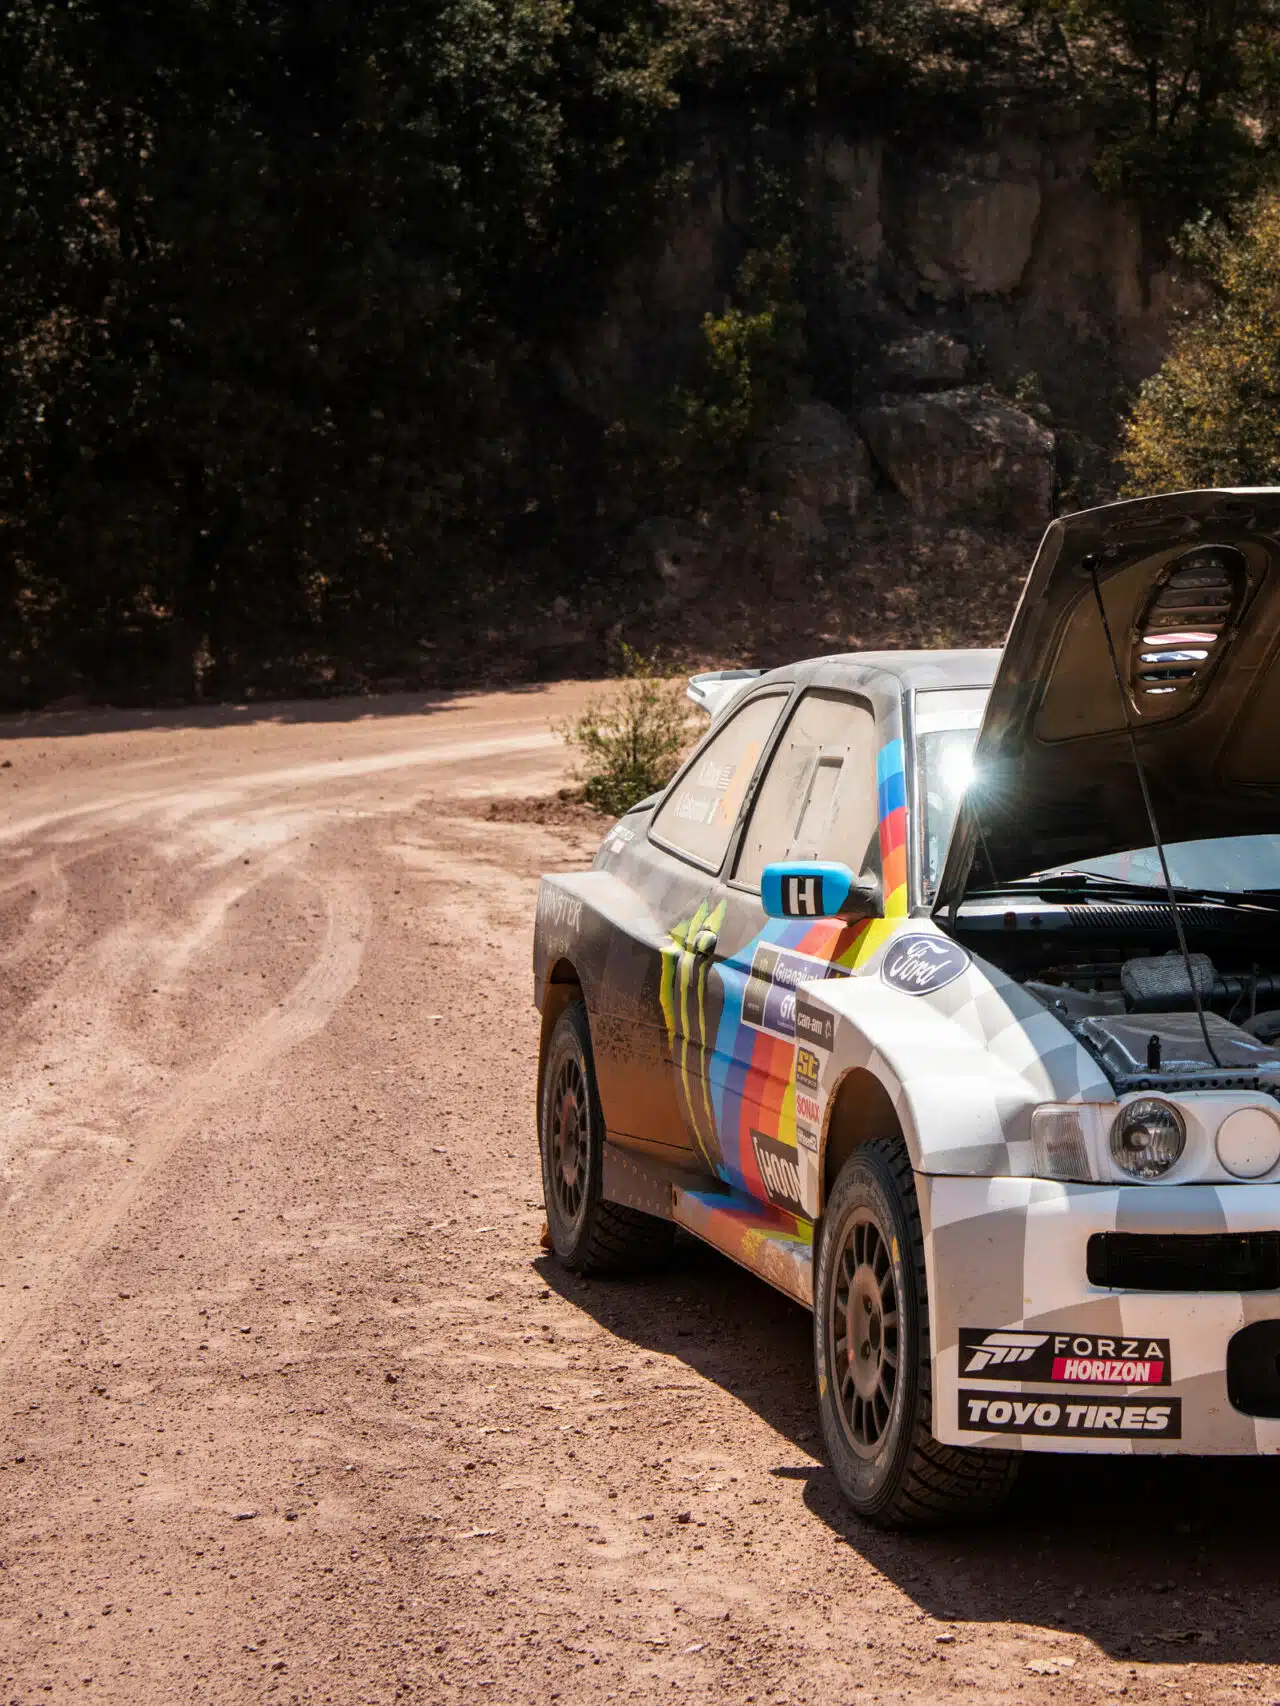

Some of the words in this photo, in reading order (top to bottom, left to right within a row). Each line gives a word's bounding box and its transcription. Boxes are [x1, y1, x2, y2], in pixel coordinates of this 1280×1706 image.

[789, 878, 816, 915] H
[889, 940, 953, 986] Ford
[797, 1012, 823, 1036] can-am
[797, 1095, 820, 1122] SONAX
[1054, 1336, 1164, 1359] FORZA
[1064, 1359, 1151, 1382] HORIZON
[967, 1400, 1061, 1427] TOYO
[1066, 1404, 1172, 1430] TIRES
